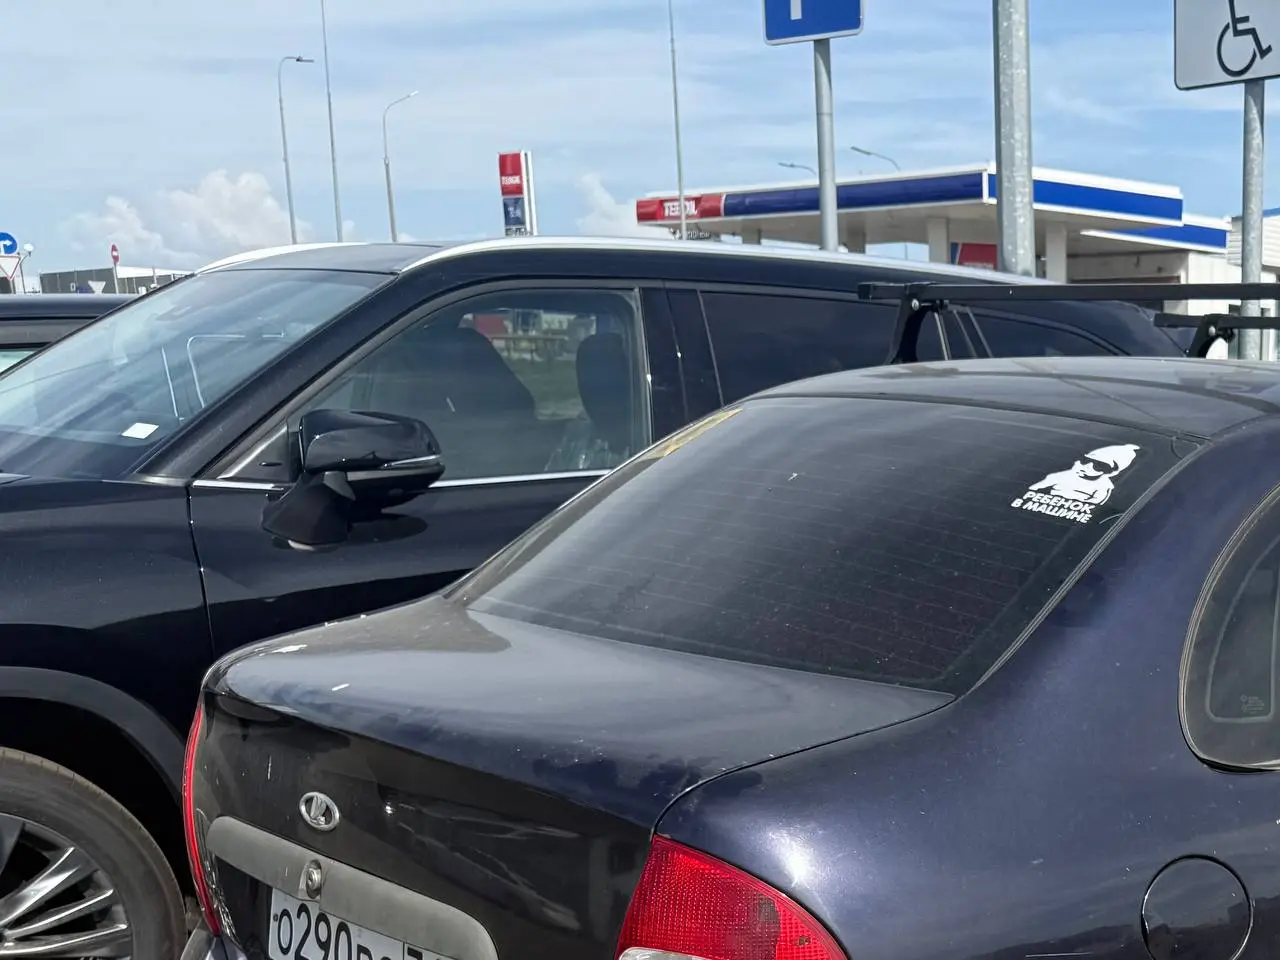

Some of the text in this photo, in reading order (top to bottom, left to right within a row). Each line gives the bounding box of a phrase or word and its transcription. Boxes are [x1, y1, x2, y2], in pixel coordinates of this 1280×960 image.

[1011, 498, 1093, 524] В МАШИНЕ
[1023, 491, 1096, 514] РЕБЕНОК
